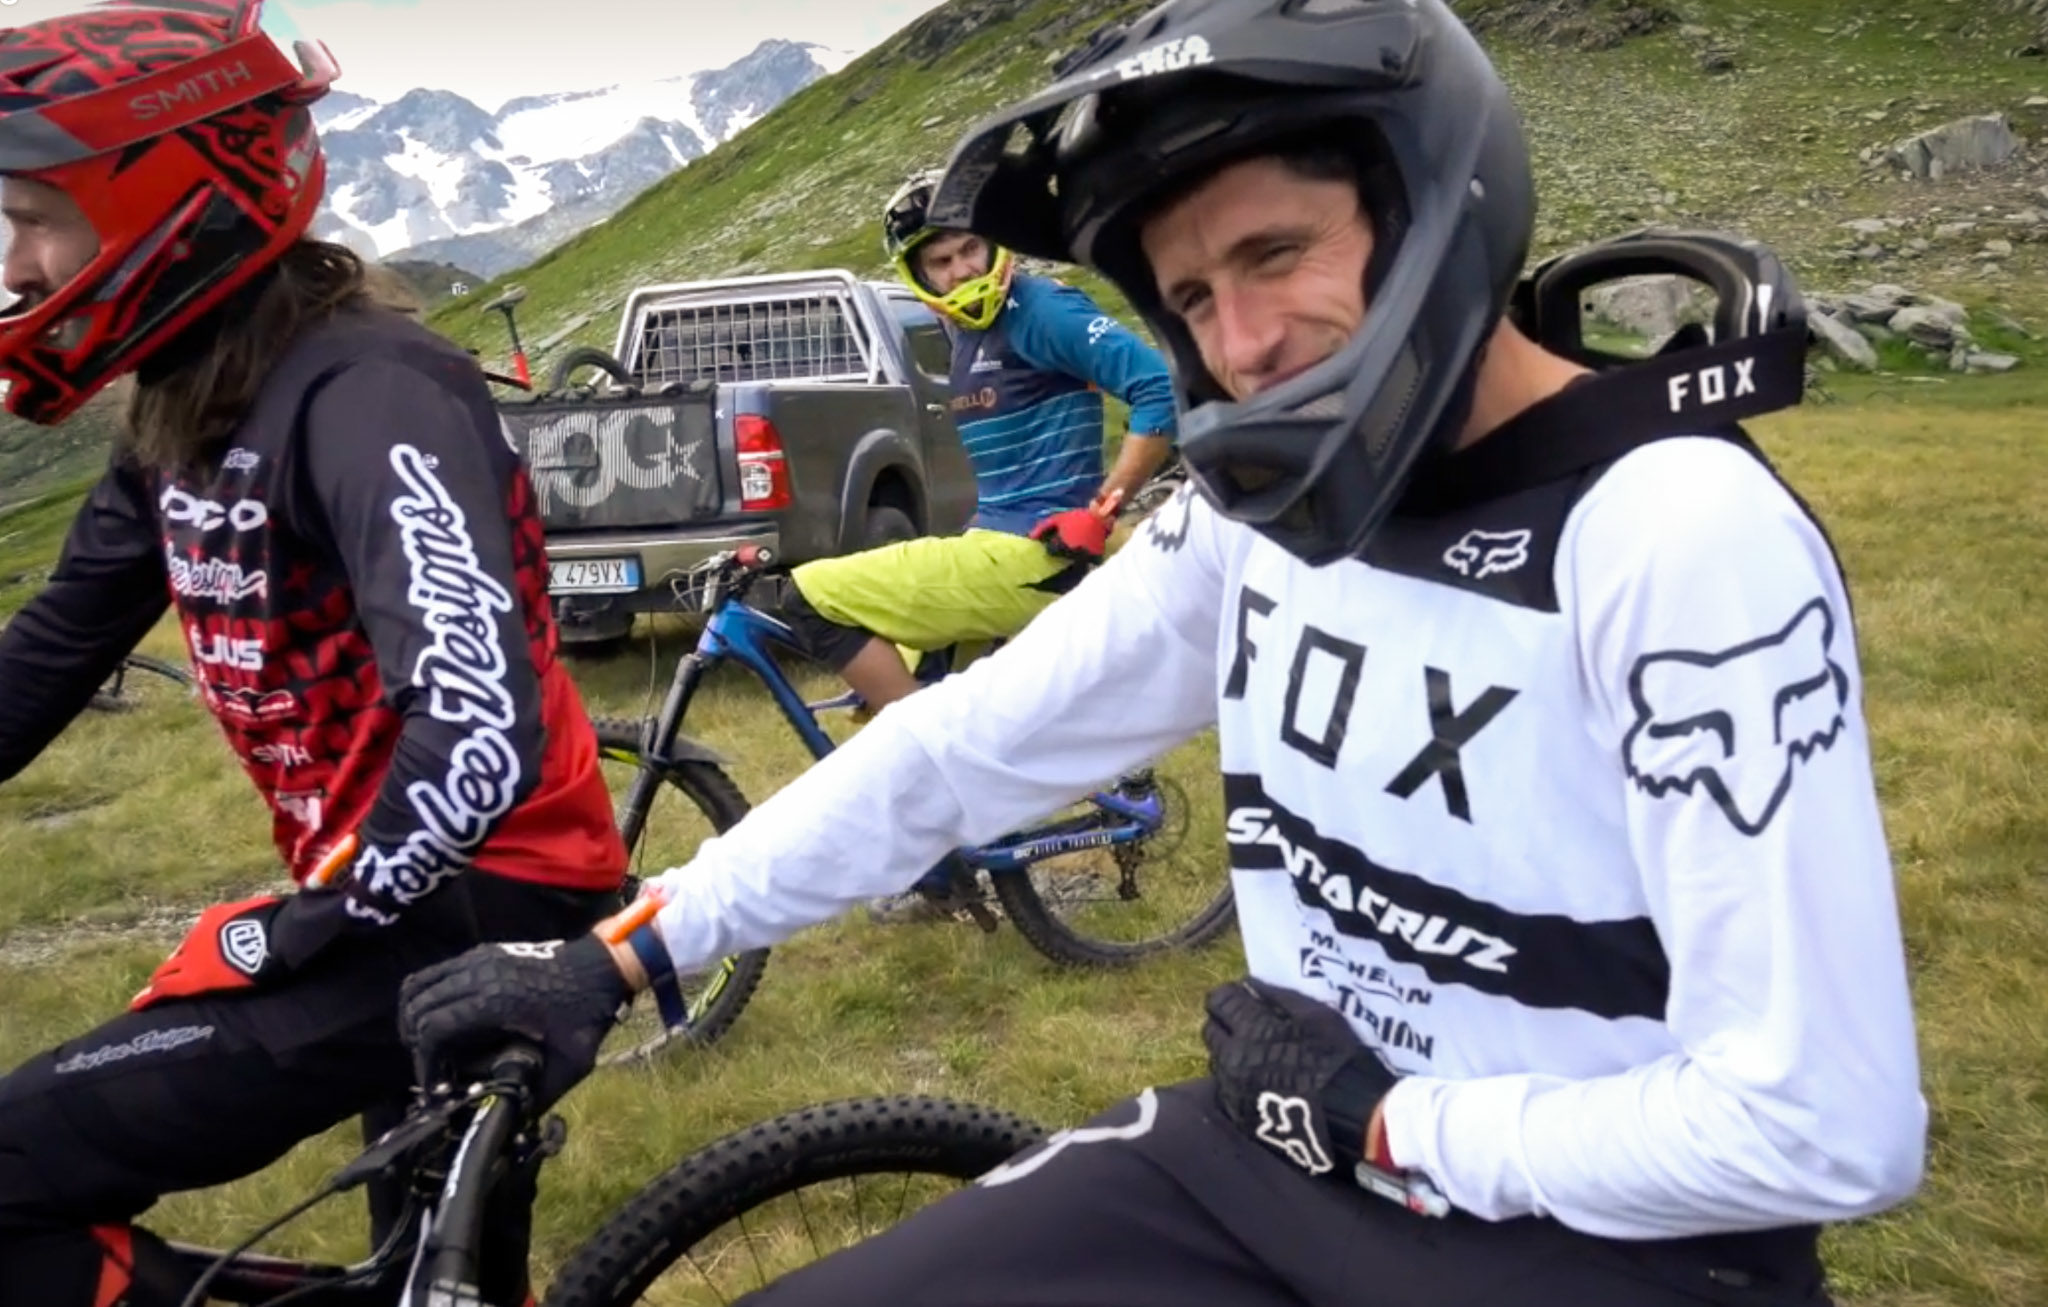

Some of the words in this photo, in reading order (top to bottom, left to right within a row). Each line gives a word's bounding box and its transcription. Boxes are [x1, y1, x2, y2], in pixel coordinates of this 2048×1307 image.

[128, 60, 253, 120] SMITH
[1667, 356, 1755, 413] FOX
[390, 443, 516, 730] Designs
[566, 560, 624, 586] 479VX
[1224, 585, 1520, 824] FOX
[406, 726, 521, 849] Lee
[1309, 929, 1434, 1005] MIHELIN
